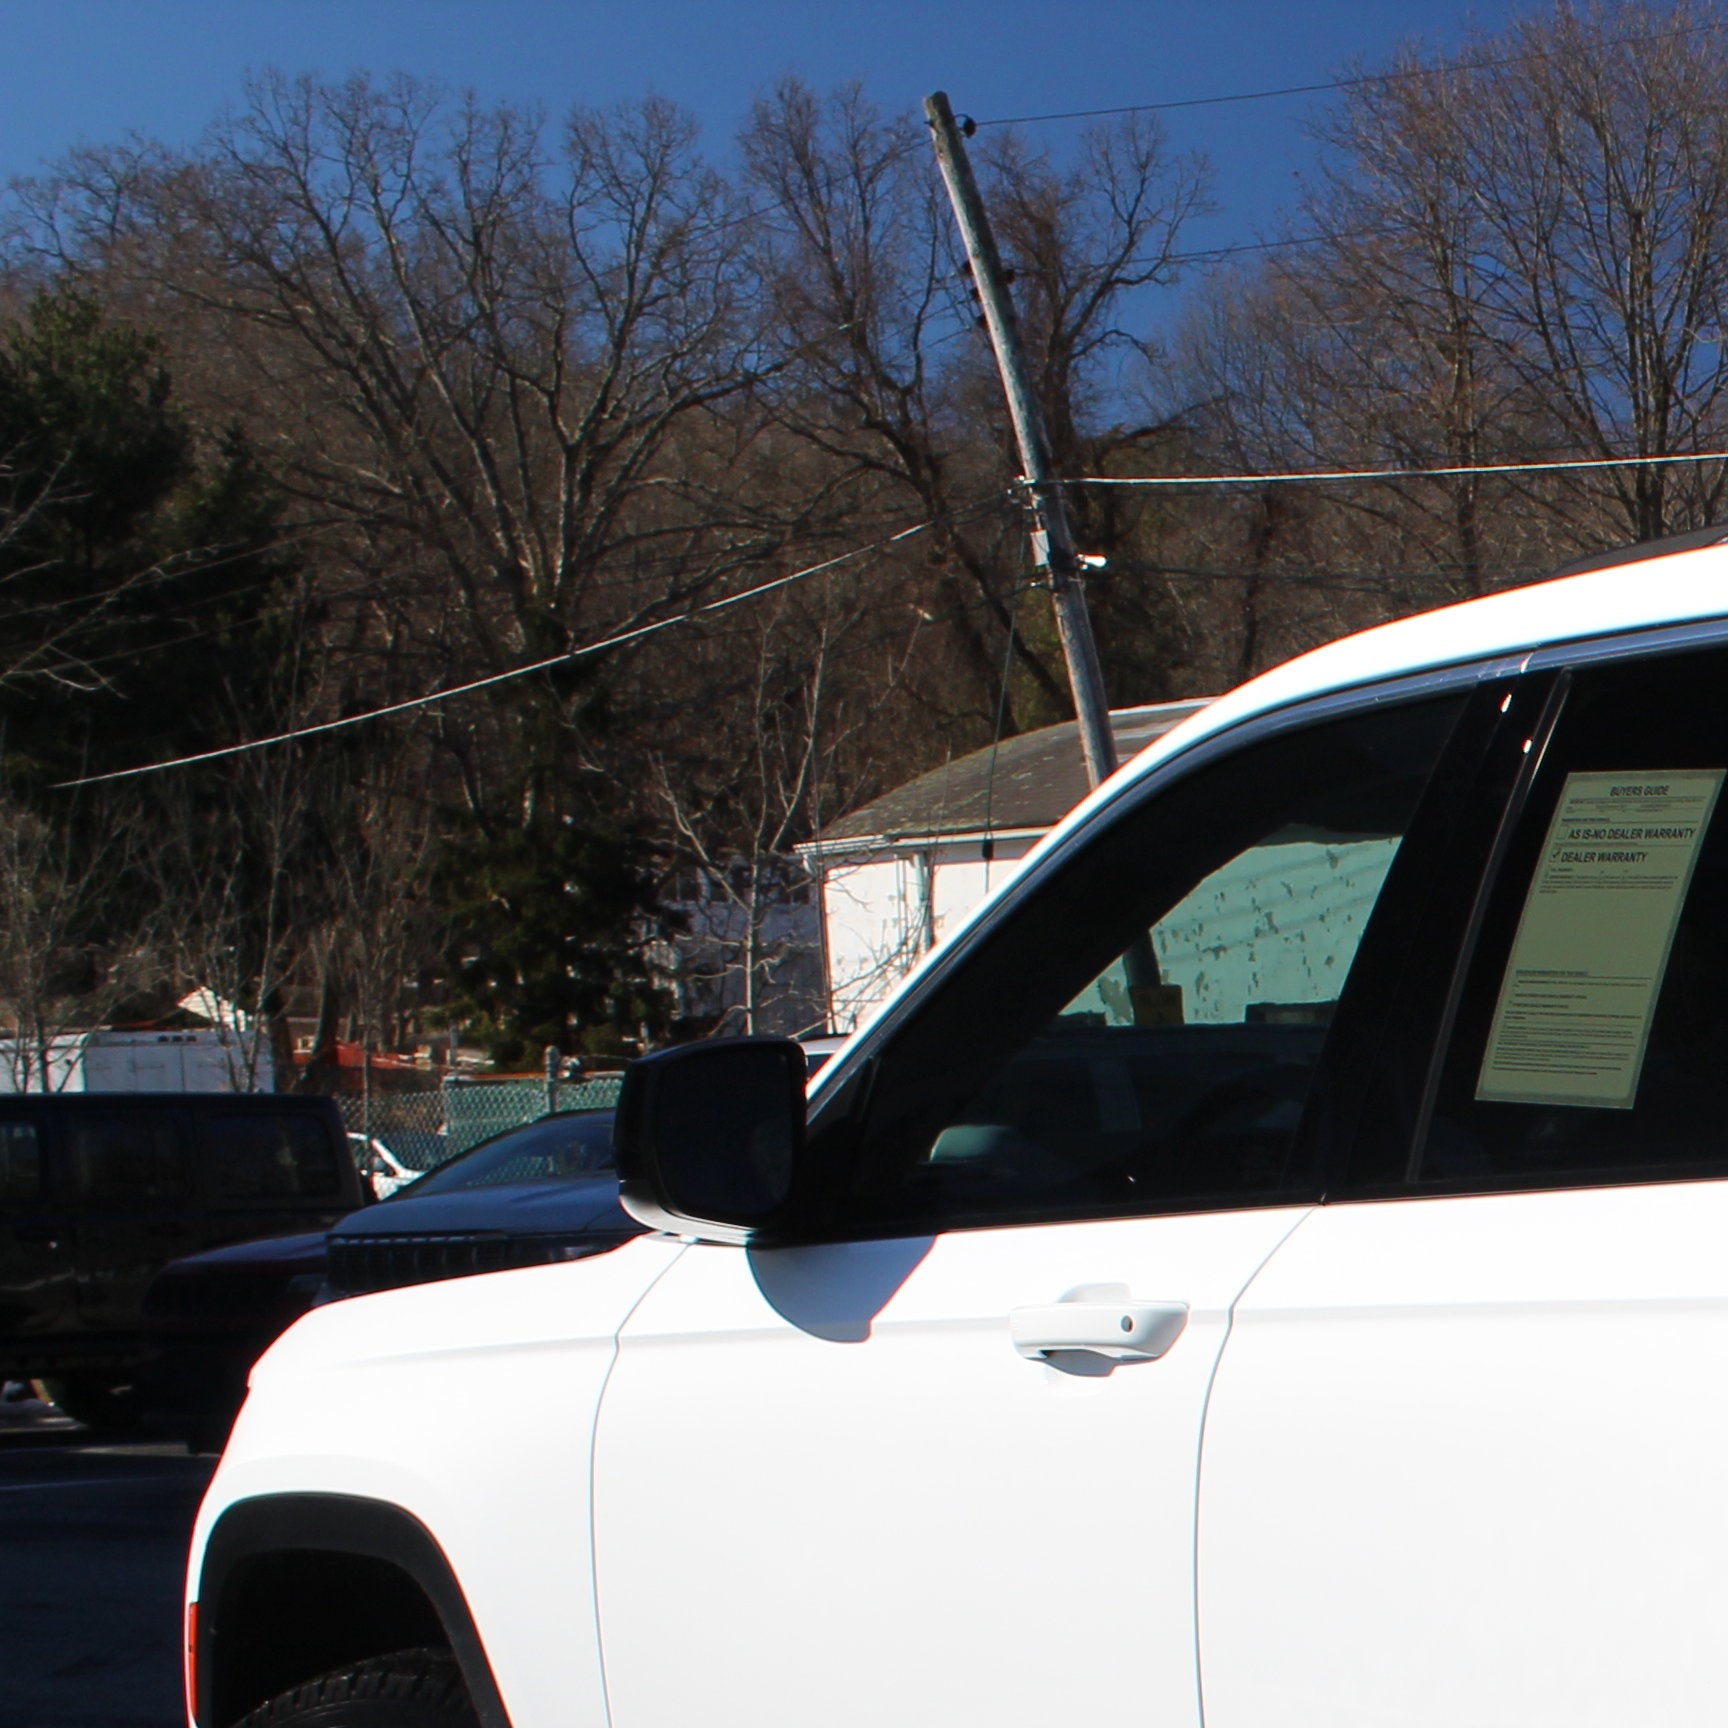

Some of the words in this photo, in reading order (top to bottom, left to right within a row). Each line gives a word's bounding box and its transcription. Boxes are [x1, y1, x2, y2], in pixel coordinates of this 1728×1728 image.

[1610, 785, 1643, 797] BUYERS
[1643, 785, 1671, 796] GUIDE
[1568, 829, 1581, 839] AS
[1607, 828, 1643, 840] DEALER
[1644, 827, 1697, 839] WARRANTY
[1560, 852, 1597, 863] DEALER
[1597, 851, 1649, 863] WARRANTY
